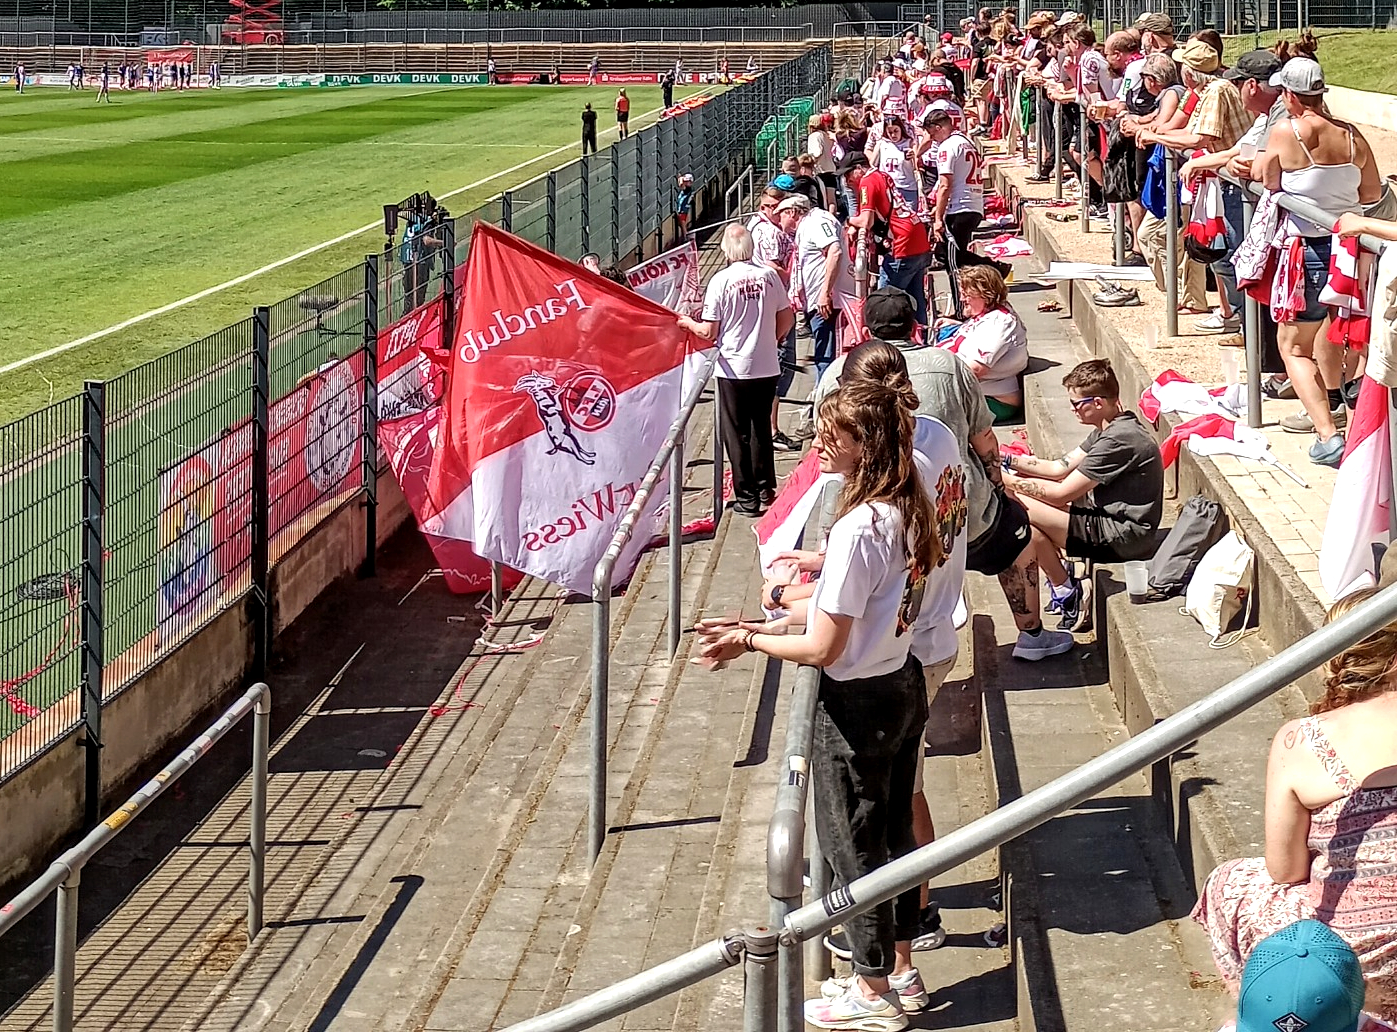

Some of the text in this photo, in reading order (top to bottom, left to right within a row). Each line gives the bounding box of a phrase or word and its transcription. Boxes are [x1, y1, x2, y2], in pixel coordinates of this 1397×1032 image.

[373, 74, 401, 83] DEVK
[412, 74, 440, 83] DEVK
[451, 74, 480, 83] DEVK
